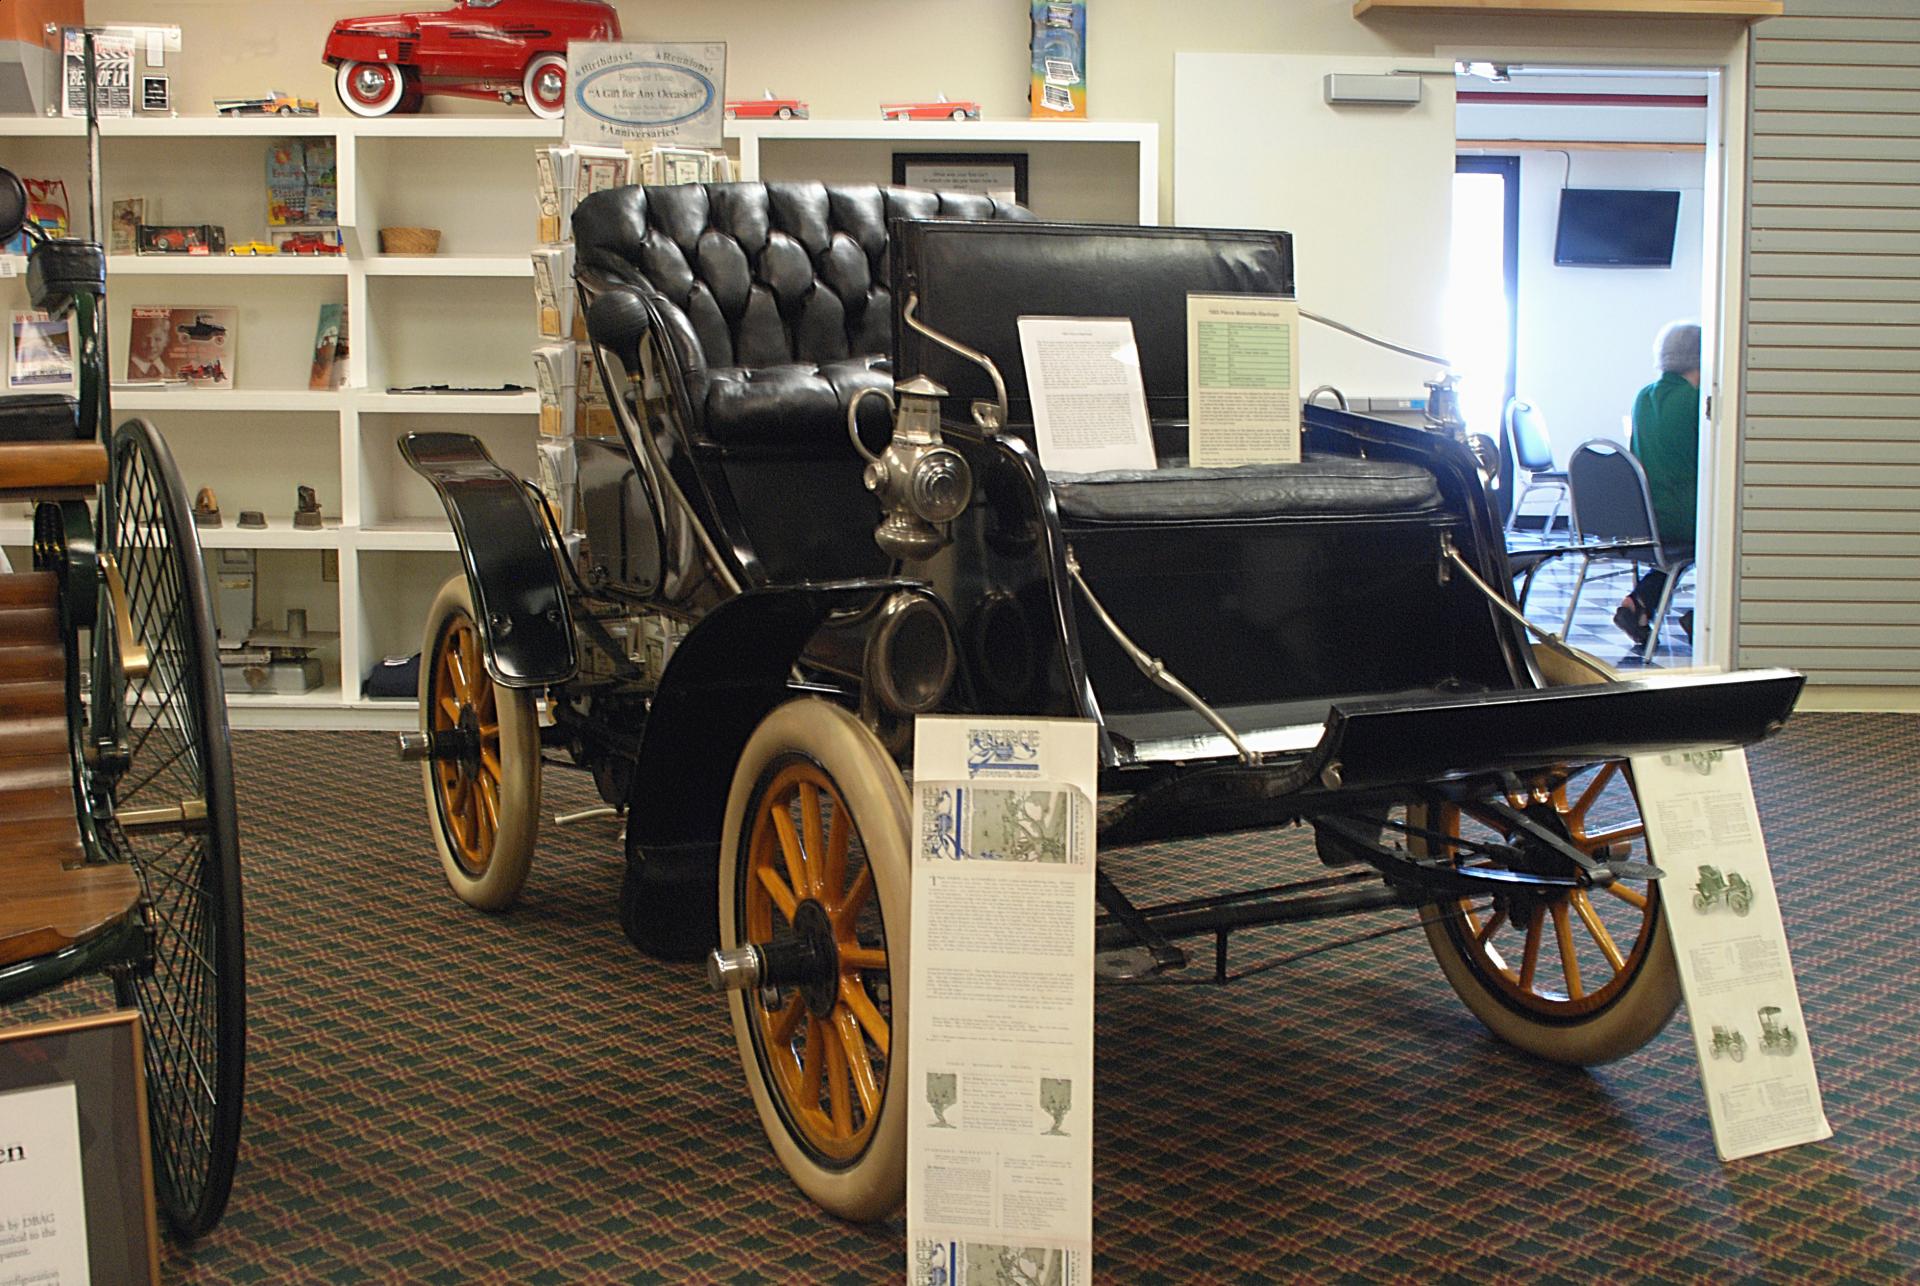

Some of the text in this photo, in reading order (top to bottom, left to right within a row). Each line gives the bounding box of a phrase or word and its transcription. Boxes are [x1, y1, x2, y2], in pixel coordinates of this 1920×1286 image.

[580, 52, 633, 74] Birthdays!
[663, 52, 714, 75] Reunions!
[97, 69, 112, 86] OF
[112, 69, 127, 86] LA
[602, 89, 620, 98] Gift
[622, 89, 636, 98] for
[639, 90, 655, 100] Any
[608, 126, 680, 139] Anniversaries!
[29, 1232, 39, 1241] to
[41, 1228, 56, 1238] the
